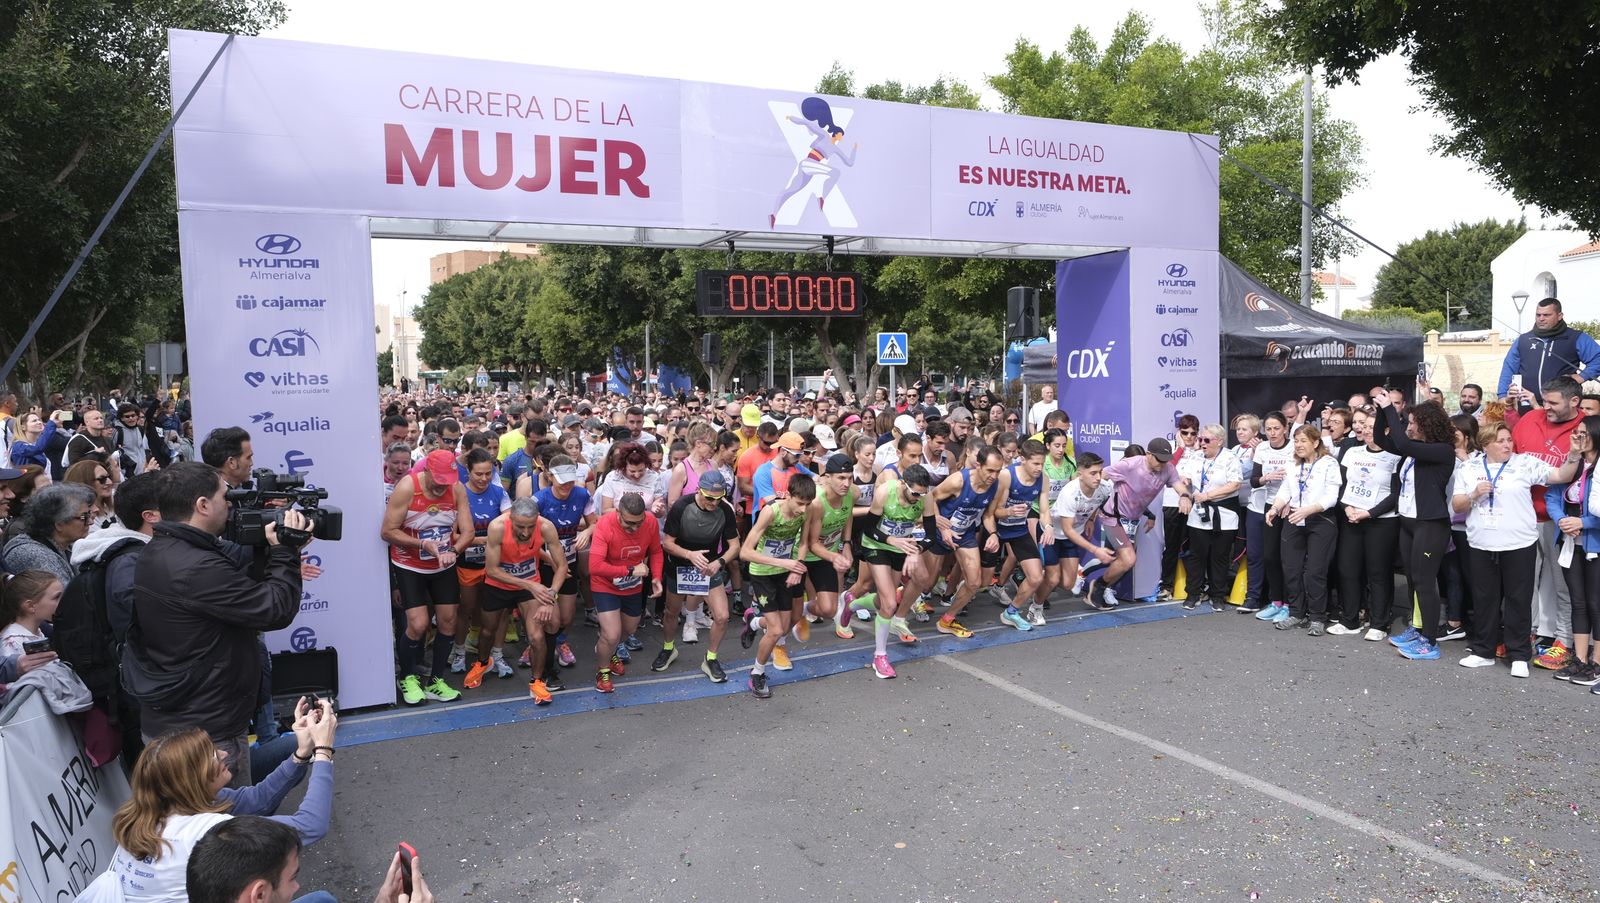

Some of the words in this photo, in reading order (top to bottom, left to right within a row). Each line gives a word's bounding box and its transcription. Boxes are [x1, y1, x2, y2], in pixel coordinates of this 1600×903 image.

[399, 84, 544, 120] CARRERA
[554, 97, 590, 123] DE
[600, 101, 634, 127] LA
[988, 136, 1011, 155] LA
[1016, 138, 1105, 163] IGUALDAD
[384, 123, 650, 199] MUJER
[959, 165, 983, 185] ES
[988, 167, 1075, 191] NUESTRA
[1078, 174, 1131, 195] META.
[968, 200, 998, 217] CDX
[239, 258, 320, 269] HYUNDAI
[250, 271, 311, 281] Almerialva
[1158, 279, 1196, 288] HYUNDAI
[262, 296, 327, 311] cajamar
[1168, 305, 1198, 315] cajamar
[249, 337, 306, 357] CASI
[1161, 333, 1188, 347] CASI
[1067, 344, 1114, 379] CDX
[1169, 357, 1197, 367] vithas
[271, 371, 329, 386] vithas
[1165, 387, 1197, 401] aqualia
[263, 416, 331, 436] aqualia
[1080, 421, 1121, 436] ALMERÍA
[1080, 435, 1101, 444] CIUDAD
[1350, 485, 1373, 498] 1359
[682, 573, 706, 582] 2022
[300, 599, 328, 611] arón
